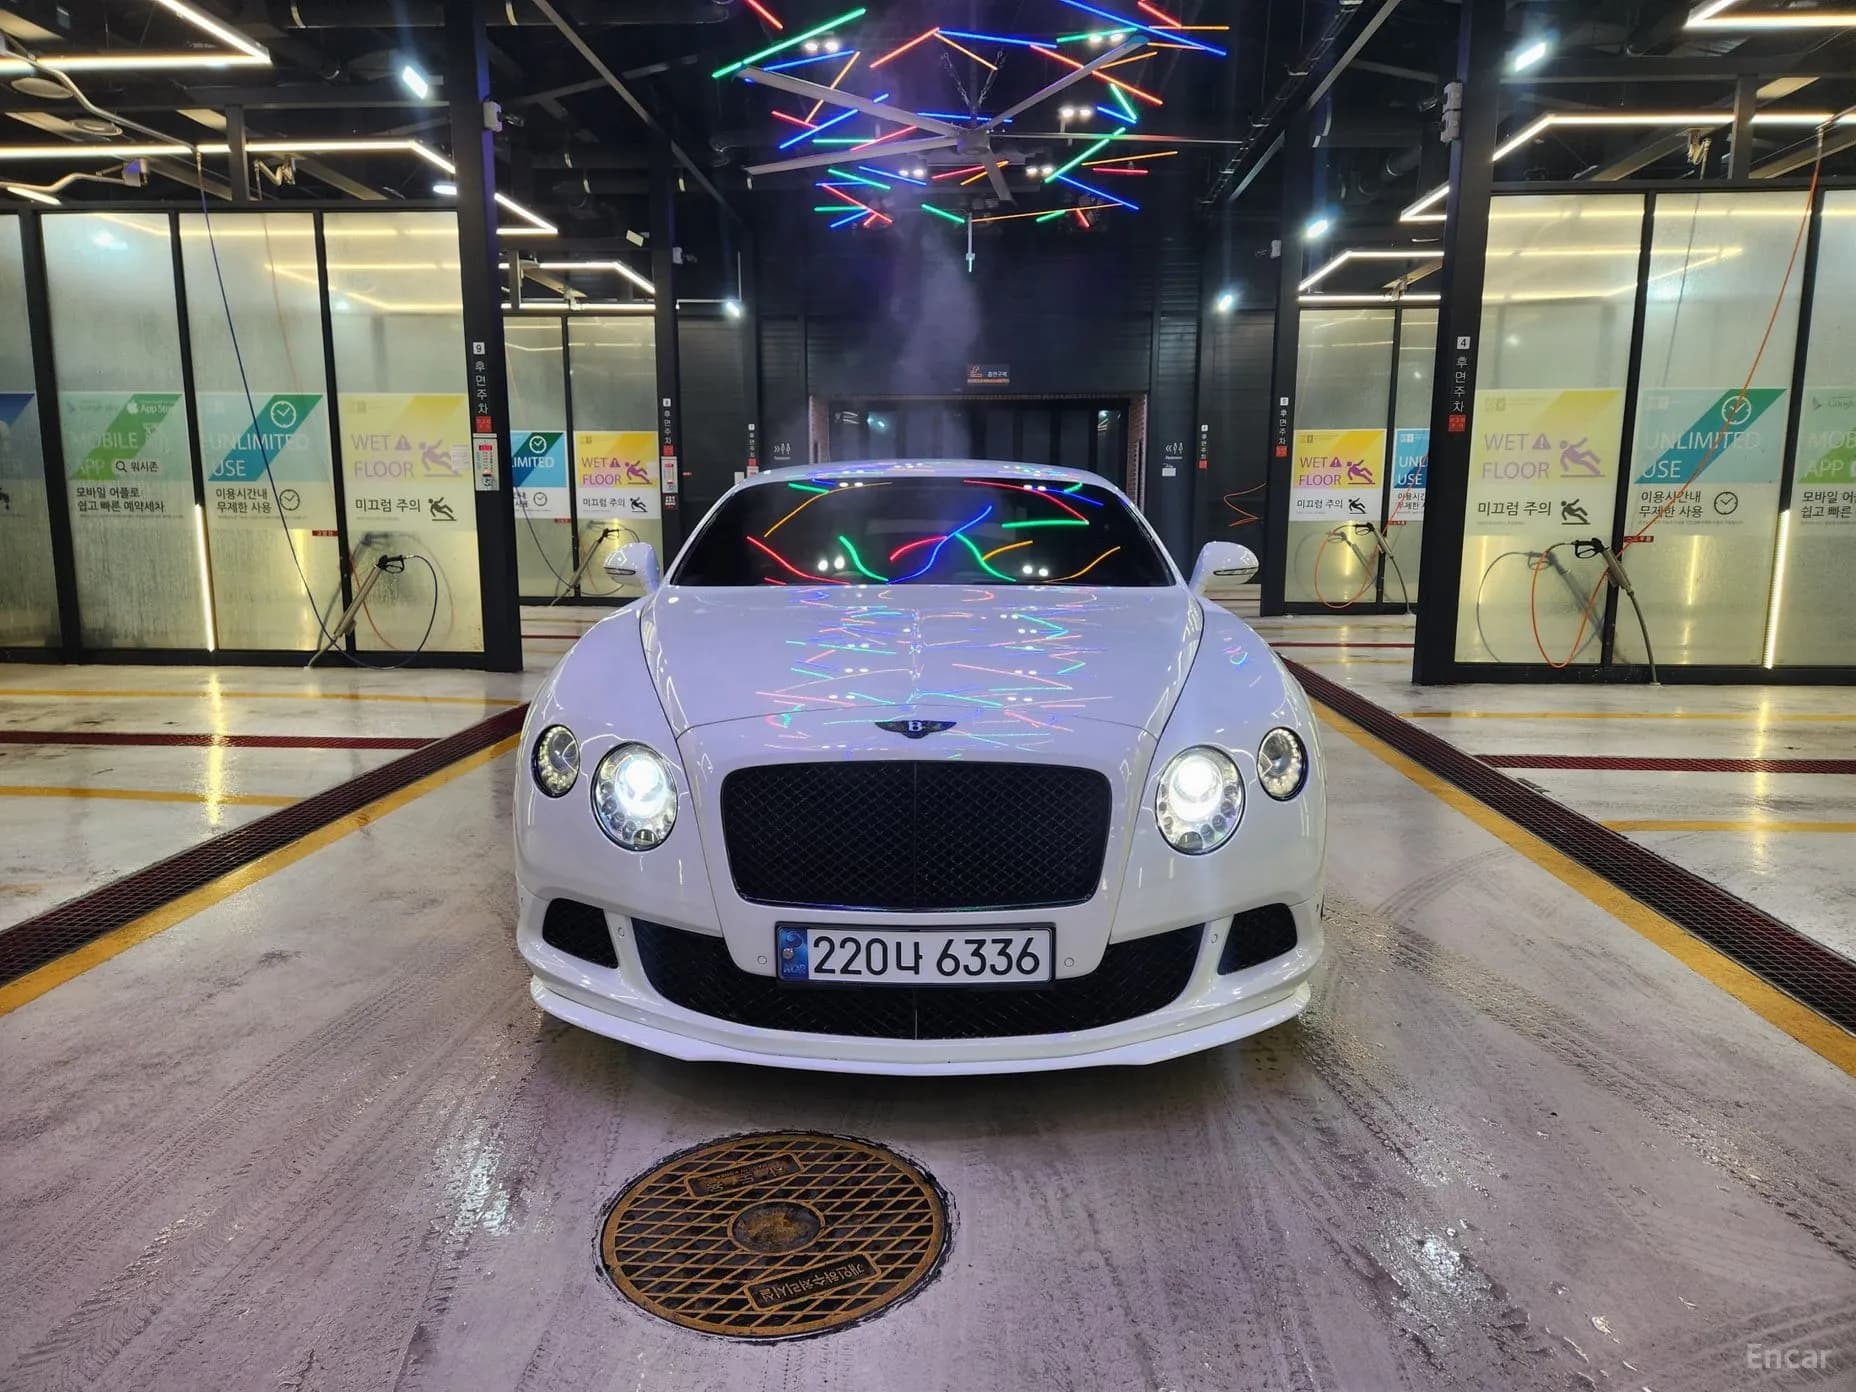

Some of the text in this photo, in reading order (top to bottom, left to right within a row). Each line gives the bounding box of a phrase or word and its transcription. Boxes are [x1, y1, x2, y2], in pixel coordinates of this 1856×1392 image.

[475, 361, 488, 415] 후면주차
[1453, 356, 1468, 412] 후면주차
[350, 433, 393, 450] WET
[1484, 432, 1530, 451] WET
[212, 459, 247, 477] USE
[581, 456, 608, 468] WET
[1299, 456, 1328, 469] WET
[1803, 459, 1844, 478] APP
[353, 460, 415, 478] FLOOR
[1481, 461, 1550, 480] FLOOR
[1642, 460, 1682, 478] USE
[583, 473, 622, 486] FLOOR
[1298, 474, 1342, 486] FLOOR
[1397, 473, 1423, 485] USE
[76, 487, 140, 499] 모바일 어플로
[215, 487, 268, 500] 이용시간내
[1801, 491, 1856, 504] 모바일 어
[78, 500, 164, 512] 쉽고 빠른 예약세차
[216, 501, 271, 514] 무제한 사용
[355, 498, 421, 513] 미끄럼 주의
[609, 497, 626, 507] 주의
[1325, 499, 1343, 509] 주의
[1478, 501, 1552, 516] 미끄럼 주의
[1679, 505, 1703, 518] 사용
[1801, 505, 1852, 518] 쉽고 빠른
[908, 720, 922, 731] B
[813, 936, 1040, 976] 220나 6336
[758, 1262, 865, 1303] 개인하수처리시설
